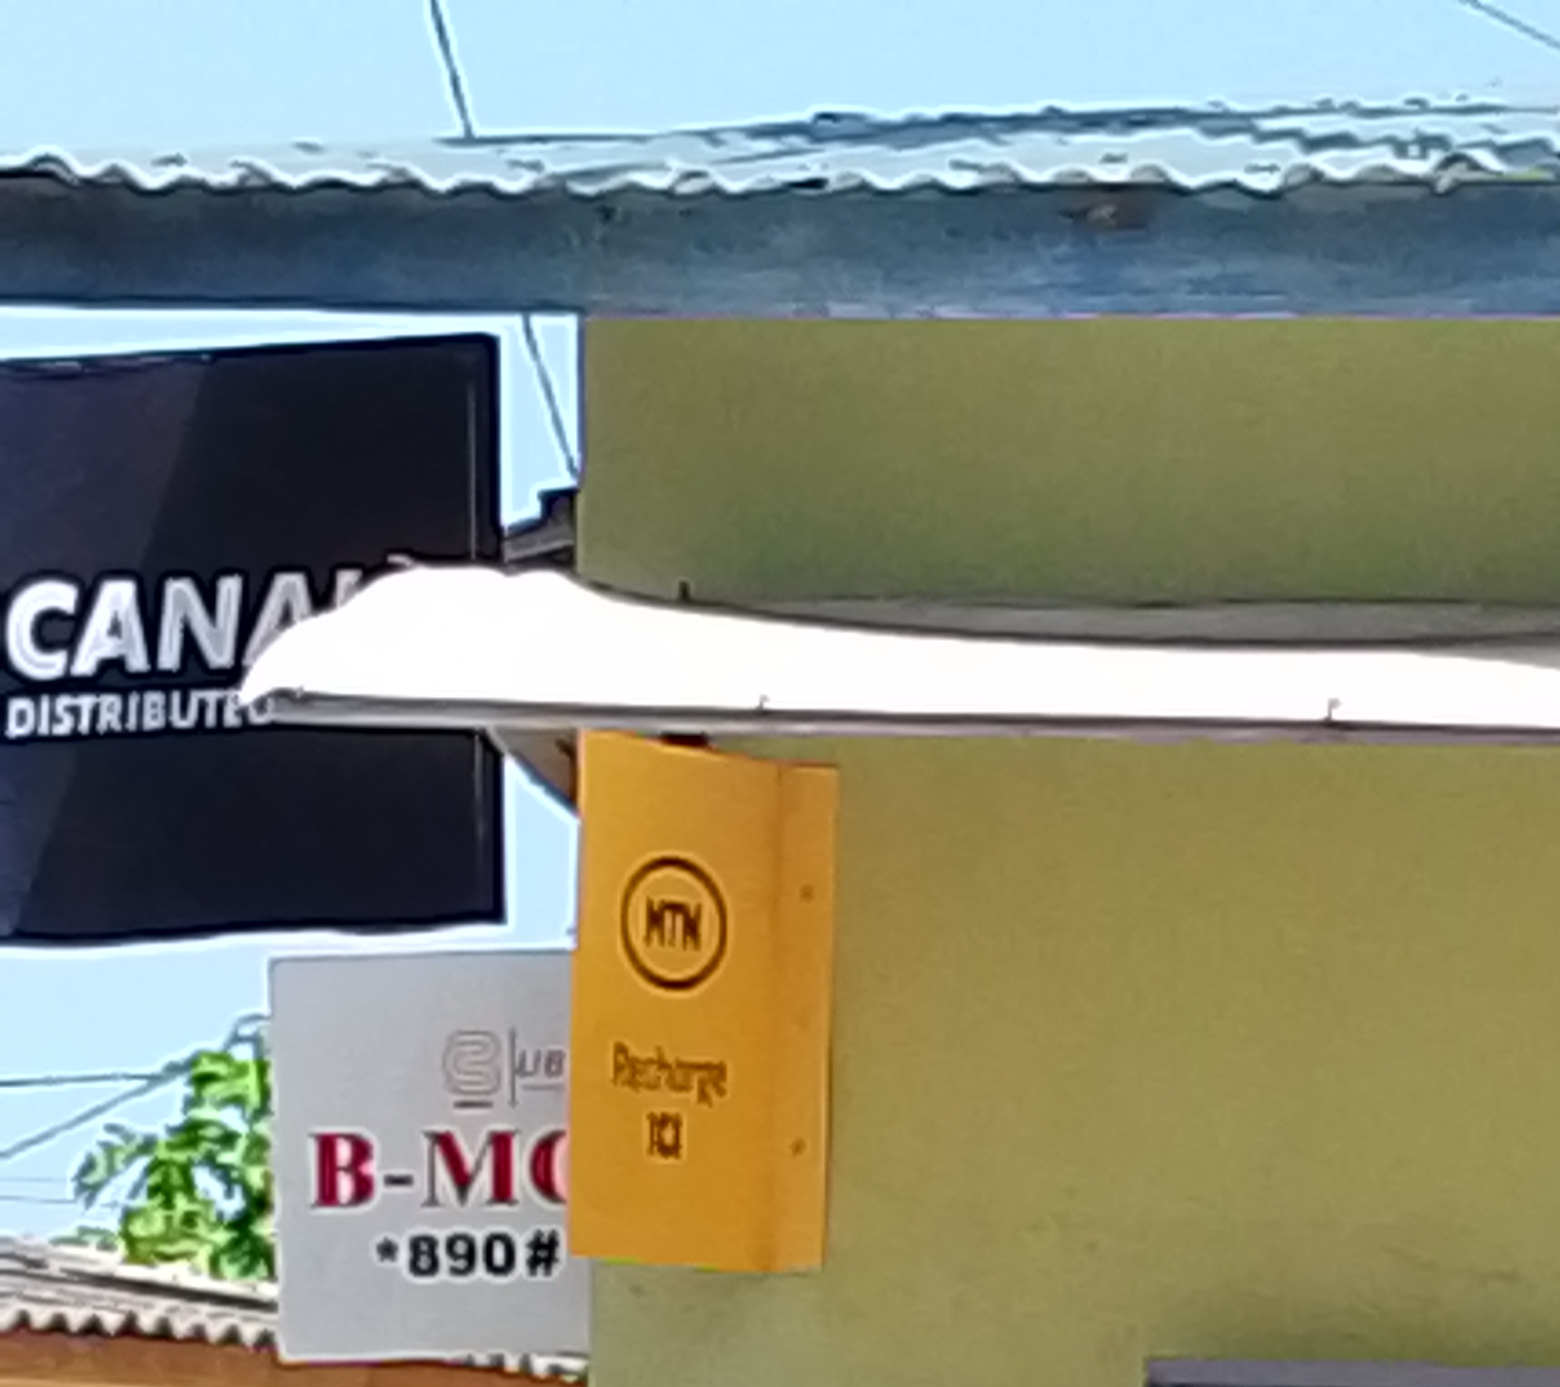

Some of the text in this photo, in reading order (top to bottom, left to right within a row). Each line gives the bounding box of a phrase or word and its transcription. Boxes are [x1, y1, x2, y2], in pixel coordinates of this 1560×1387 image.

[5, 572, 363, 680] CANA
[644, 897, 702, 951] MTN
[611, 1042, 728, 1107] Recharge
